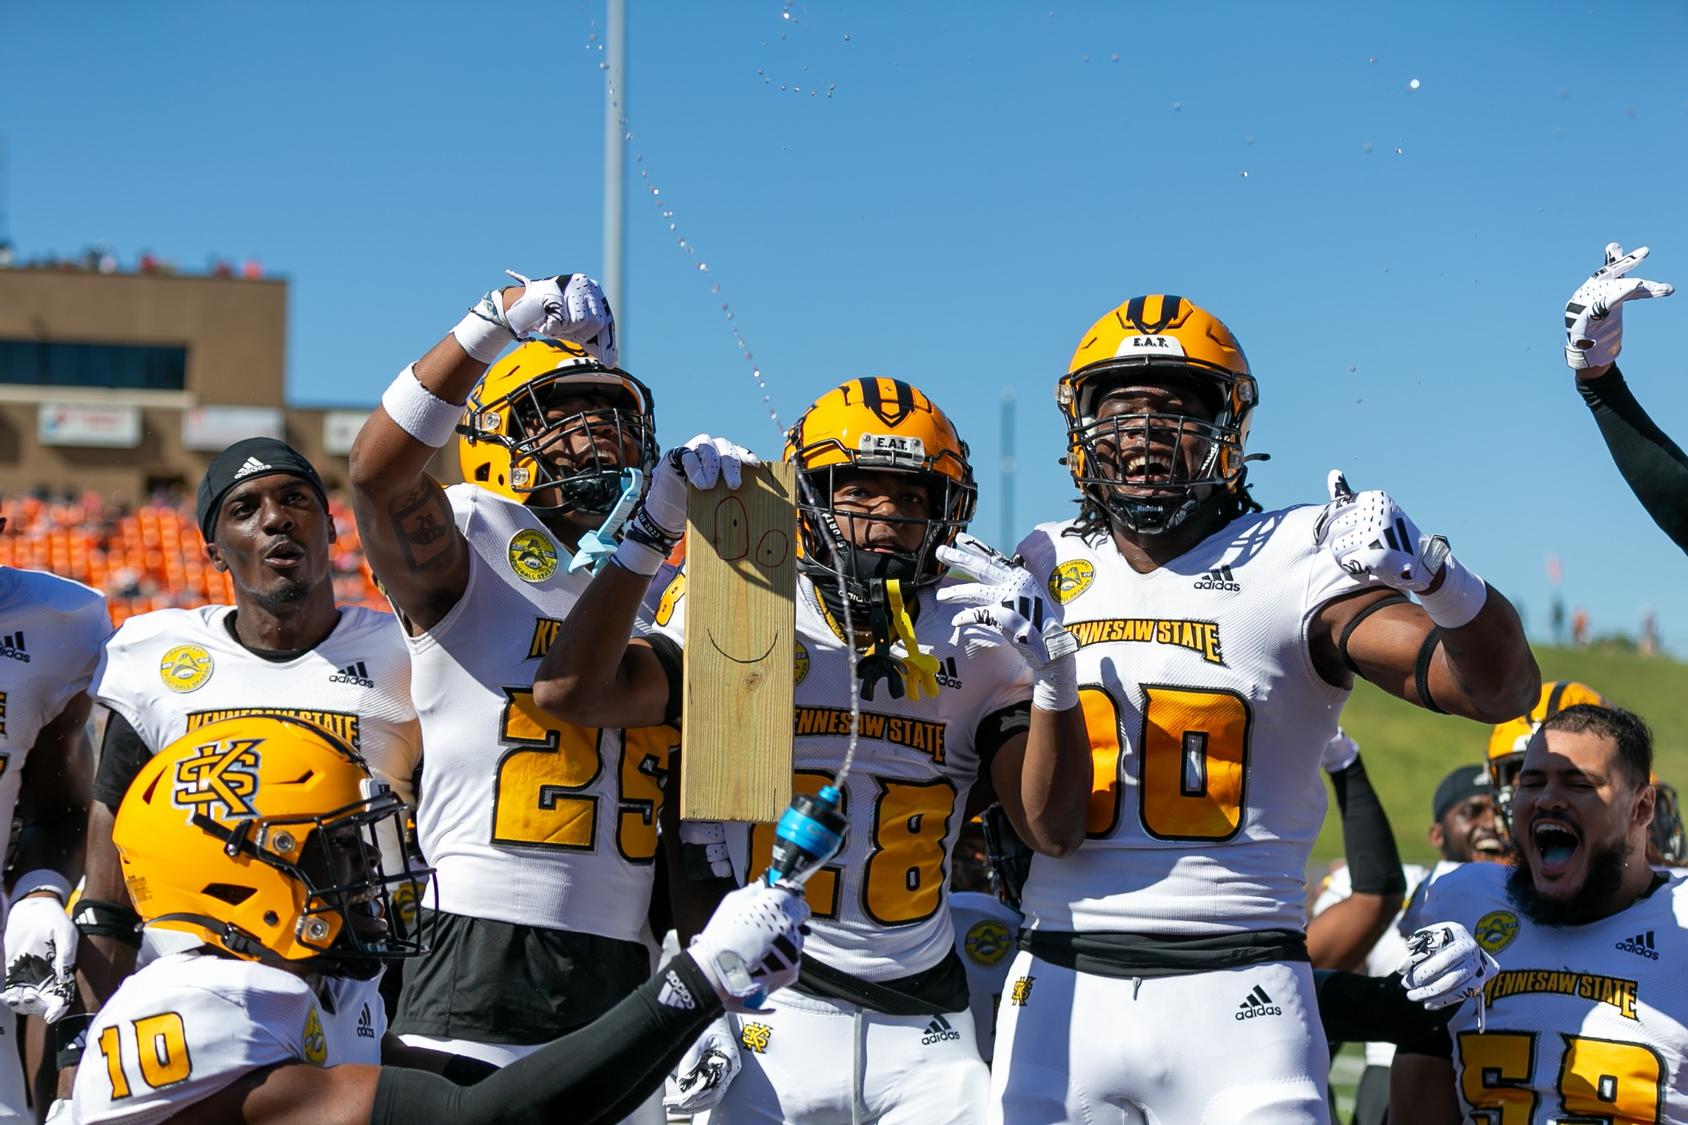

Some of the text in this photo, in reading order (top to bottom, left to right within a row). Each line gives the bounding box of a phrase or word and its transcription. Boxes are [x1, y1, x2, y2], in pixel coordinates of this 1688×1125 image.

[1133, 336, 1169, 348] E.A.T.
[876, 437, 908, 450] E.A.T.
[1193, 579, 1241, 592] adidas
[1157, 620, 1222, 664] STATE
[328, 674, 374, 689] adidas
[795, 706, 947, 765] NNESAW STATE
[1615, 942, 1660, 961] adidas
[665, 969, 696, 1010] adidas
[1484, 970, 1638, 1021] KENNESAW STATE
[1235, 1004, 1282, 1021] adidas
[921, 1029, 961, 1046] adidas
[99, 1010, 192, 1101] 10
[1456, 1028, 1668, 1125] 59
